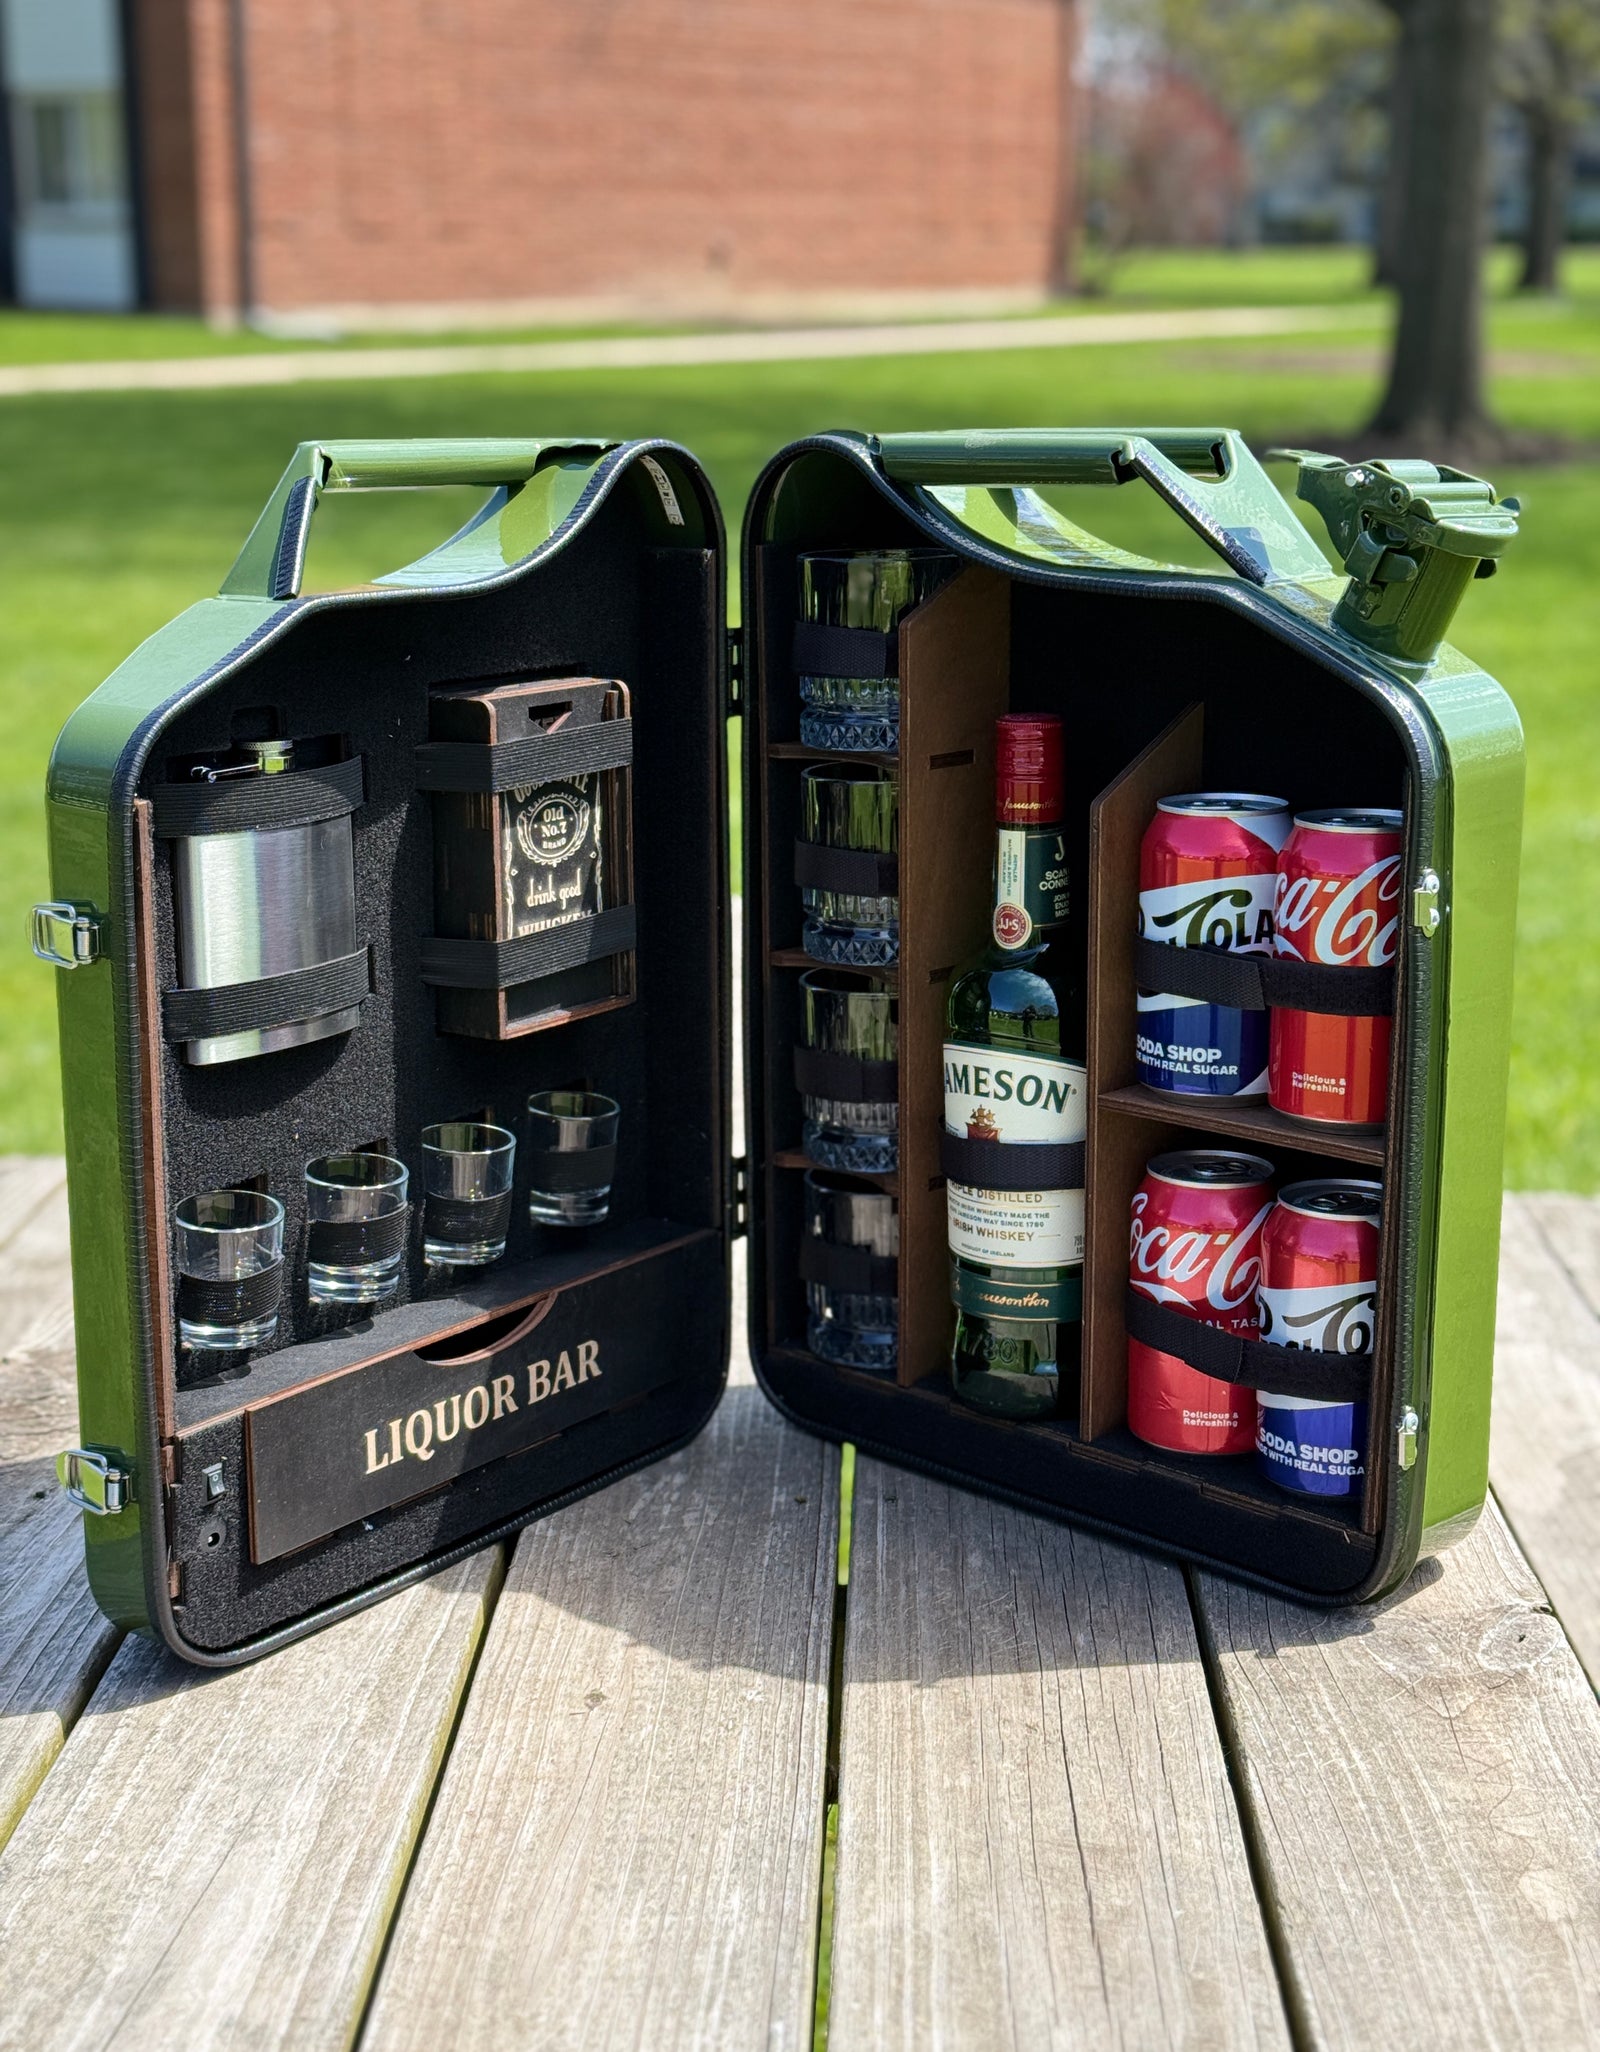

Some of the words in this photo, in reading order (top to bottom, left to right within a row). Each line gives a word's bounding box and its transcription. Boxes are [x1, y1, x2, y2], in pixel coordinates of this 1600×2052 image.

[543, 805, 565, 823] Old
[526, 874, 557, 907] drink
[1039, 877, 1070, 891] CONNE
[1136, 1034, 1165, 1058] SODA
[1166, 1044, 1222, 1063] SHOP
[1142, 1054, 1161, 1069] WITH
[1161, 1060, 1191, 1073] REAL
[1192, 1065, 1239, 1076] SUGAR
[1292, 1071, 1336, 1085] Delicious
[1338, 1078, 1347, 1086] &
[1292, 1079, 1346, 1095] Refreshing
[977, 1189, 1043, 1203] DISTILLED
[984, 1218, 999, 1226] WAY
[977, 1226, 1035, 1242] WHISKEY
[364, 1373, 520, 1475] LIQUOR
[527, 1339, 602, 1404] BAR
[1182, 1409, 1230, 1419] Delicious
[1183, 1418, 1239, 1428] Refreshing
[1259, 1428, 1297, 1457] SODA
[1300, 1444, 1359, 1465] SHOP
[1268, 1449, 1293, 1467] WITH
[1294, 1459, 1327, 1475] REAL
[1328, 1466, 1366, 1476] SUGA
